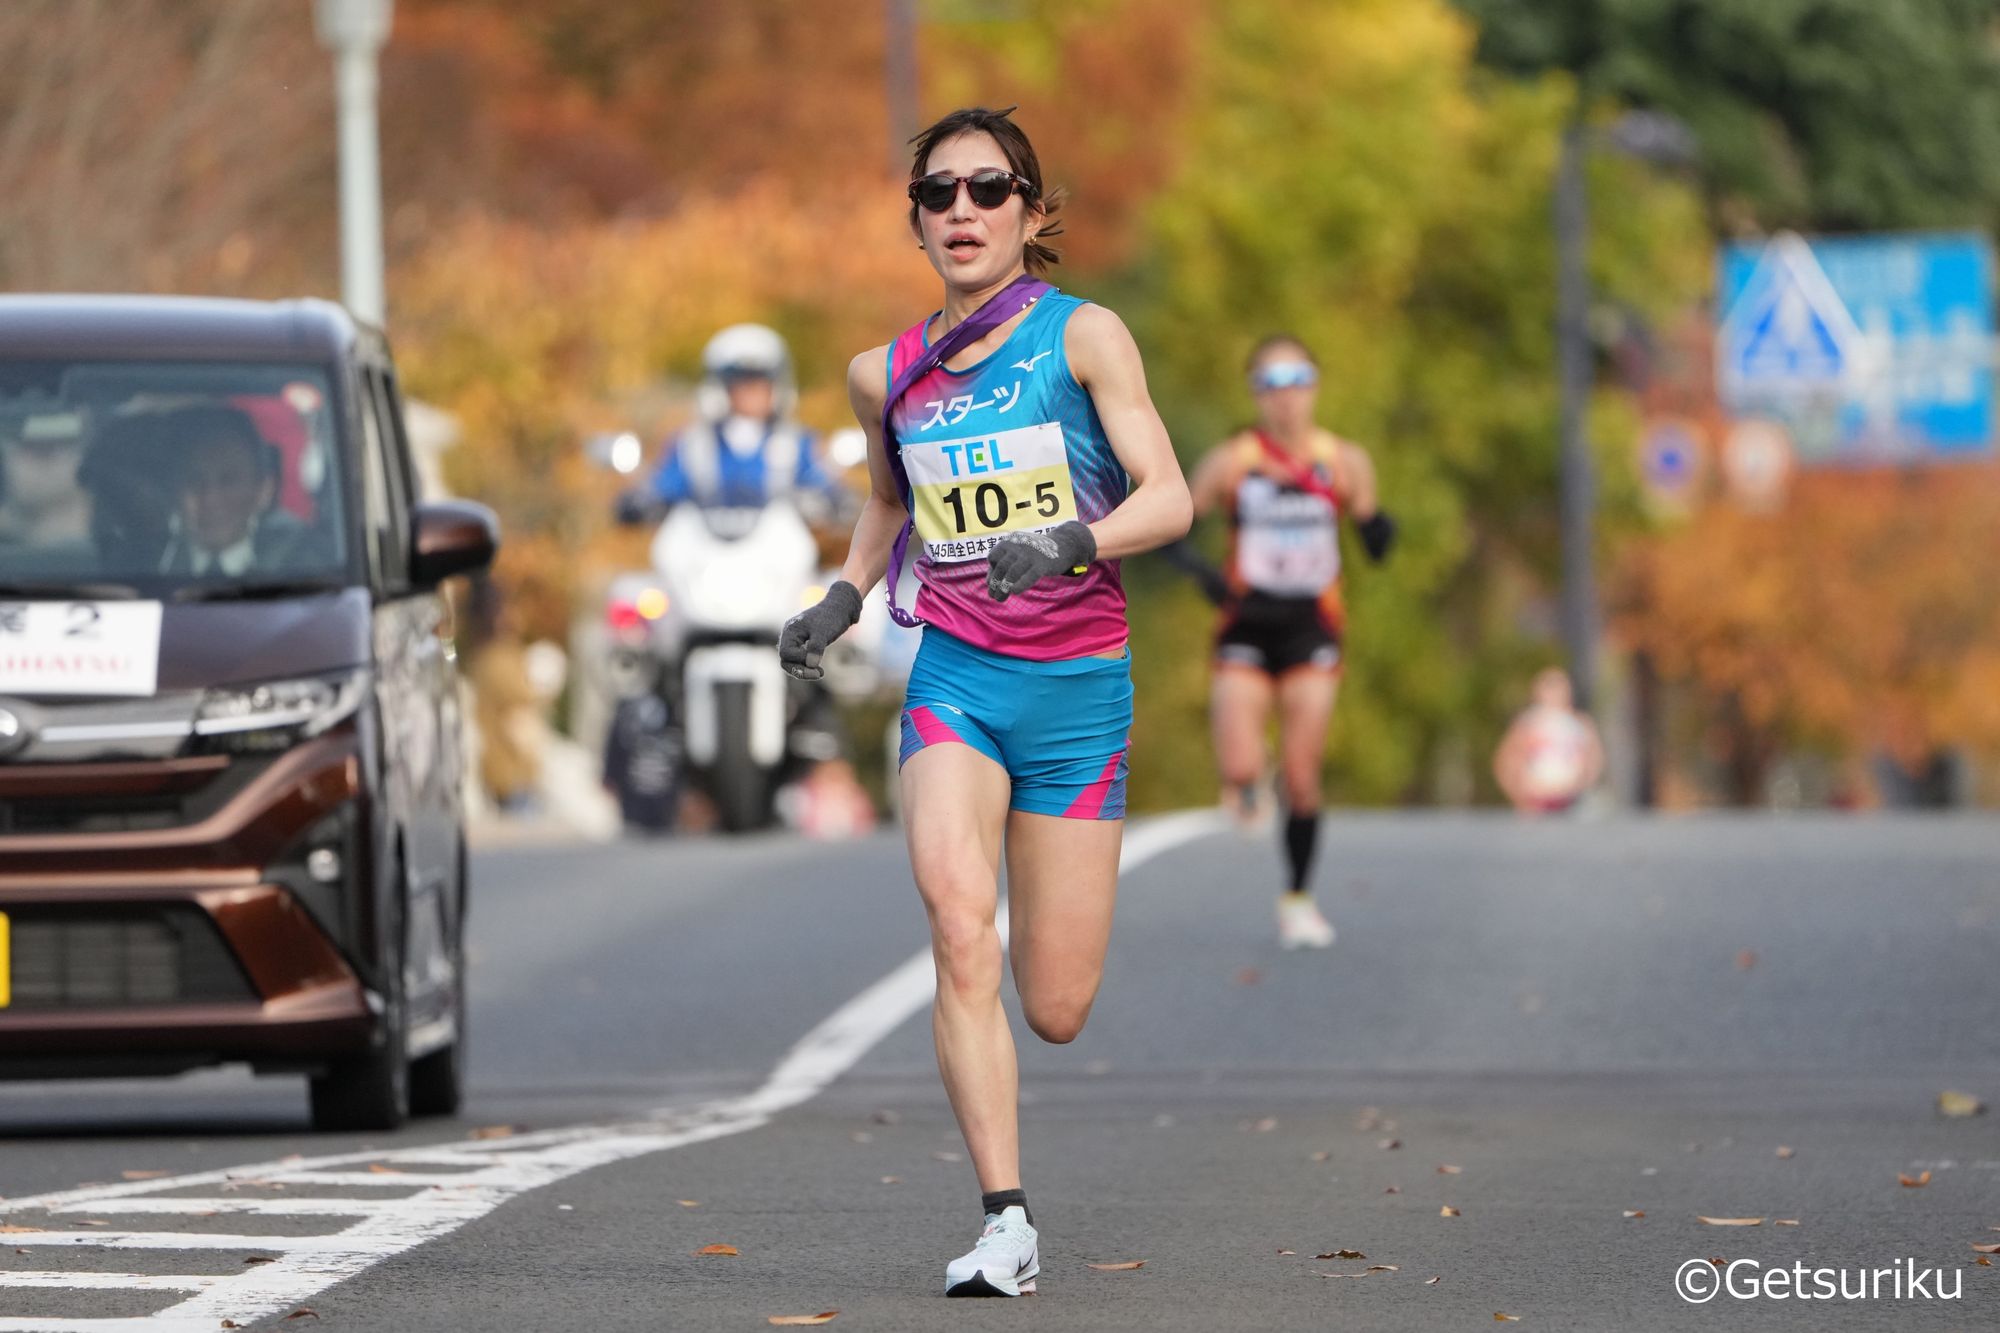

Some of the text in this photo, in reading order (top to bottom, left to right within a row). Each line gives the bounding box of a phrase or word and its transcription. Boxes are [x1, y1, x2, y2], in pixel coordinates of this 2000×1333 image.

[920, 380, 1021, 432] スターツ
[941, 439, 1014, 477] TEL
[942, 481, 1061, 534] 10-5
